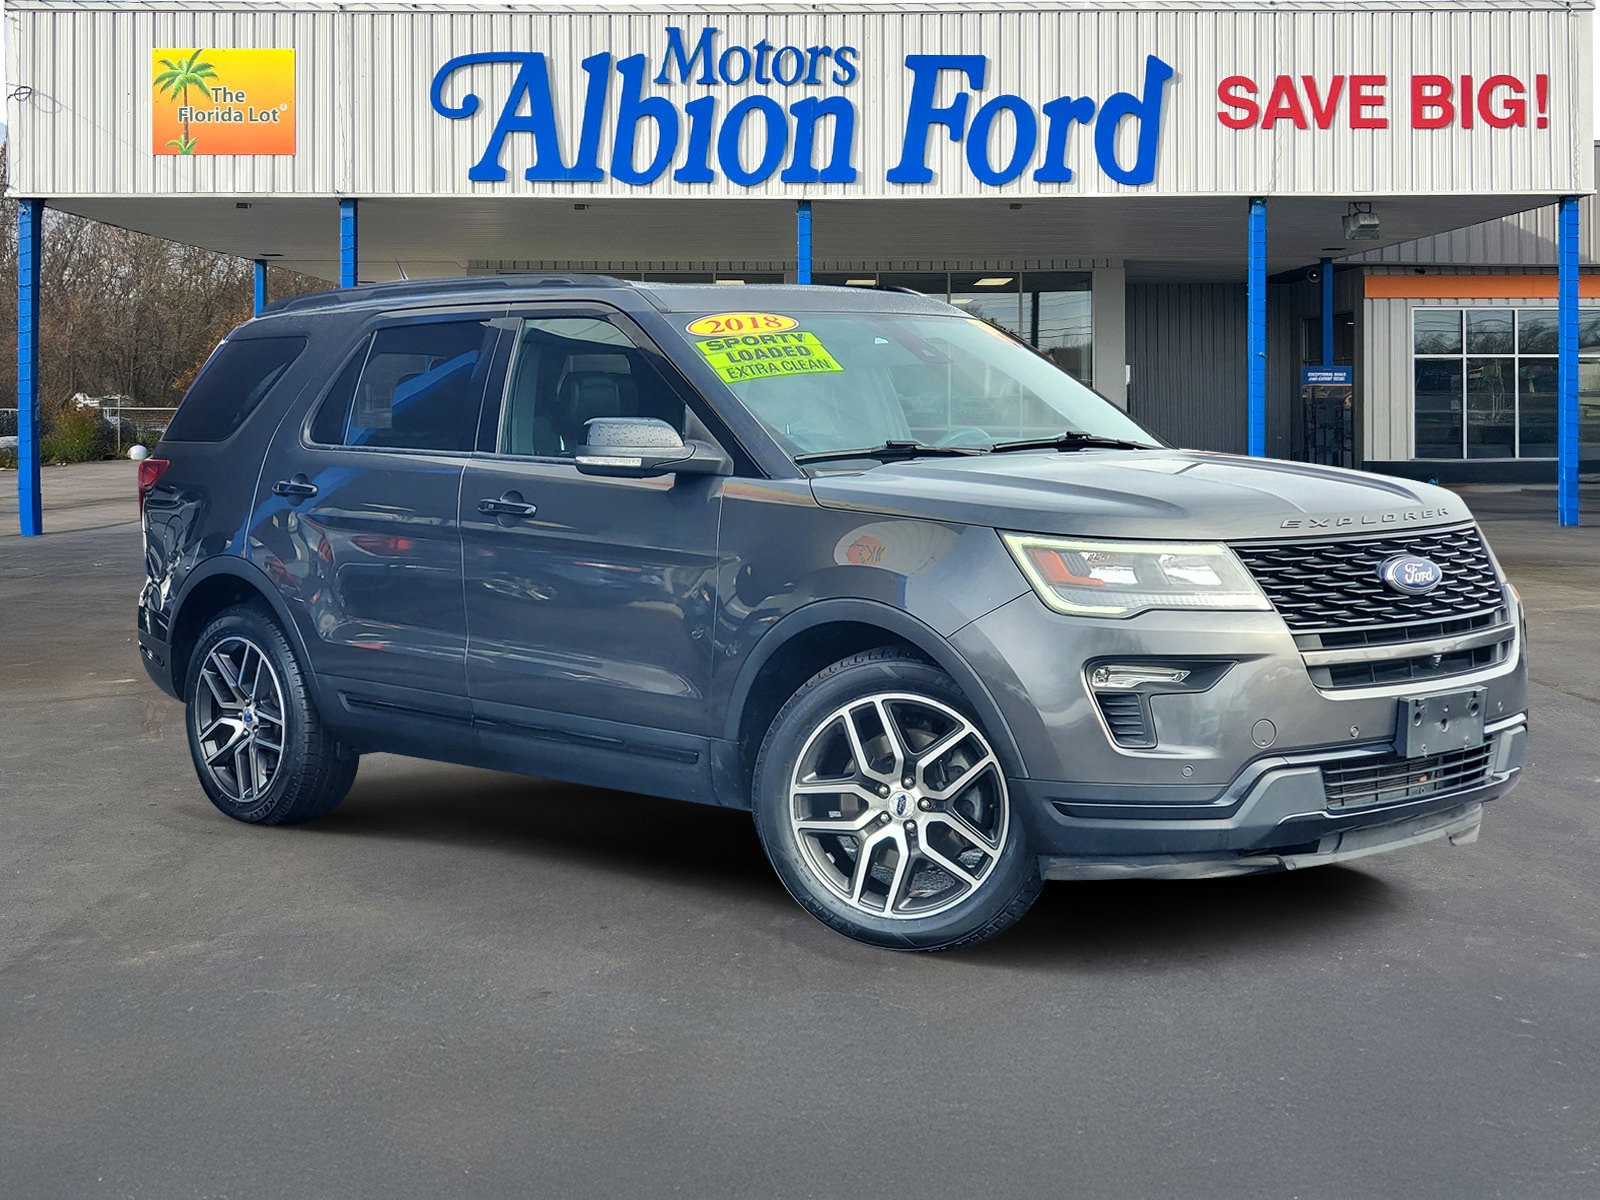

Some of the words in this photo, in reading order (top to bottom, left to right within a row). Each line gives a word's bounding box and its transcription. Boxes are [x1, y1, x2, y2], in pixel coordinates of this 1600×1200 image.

[654, 28, 857, 85] Motors
[211, 86, 246, 103] The
[1217, 75, 1388, 129] SAVE
[1411, 75, 1548, 129] BIG!
[178, 106, 243, 122] Florida
[248, 107, 279, 122] Lot
[429, 52, 857, 186] Albion
[886, 54, 1174, 186] Ford
[705, 315, 782, 334] 2018
[706, 333, 805, 351] SPORTY
[726, 345, 811, 363] LOADED
[726, 361, 781, 380] EXTRA
[781, 358, 831, 372] CLEAN
[1280, 507, 1449, 529] EXPLORER
[1404, 562, 1435, 584] Ford
